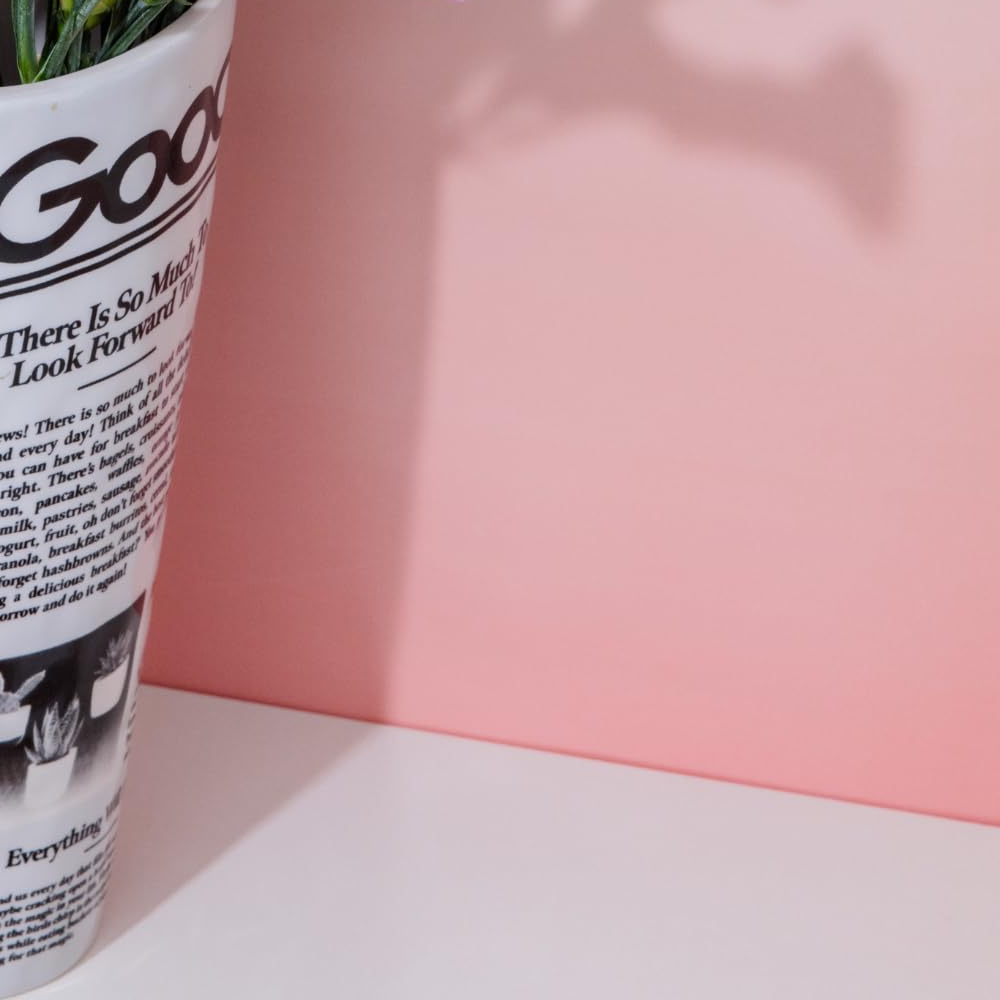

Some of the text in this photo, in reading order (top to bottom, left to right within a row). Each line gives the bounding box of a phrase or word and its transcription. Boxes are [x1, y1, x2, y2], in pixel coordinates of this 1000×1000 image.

[86, 302, 110, 334] Is
[114, 288, 144, 322] So
[146, 243, 195, 304] Much
[9, 344, 84, 388] Look
[86, 284, 177, 365] Forward
[34, 414, 76, 436] There
[81, 407, 92, 421] is
[96, 401, 110, 416] so
[113, 379, 144, 406] much
[19, 439, 58, 456] every
[64, 424, 94, 446] day!
[100, 403, 134, 433] Think
[22, 462, 47, 476] can
[53, 449, 85, 468] have
[90, 439, 110, 456] for
[0, 481, 41, 501] right.
[48, 462, 95, 487] There's
[35, 482, 98, 514] pancakes,
[0, 518, 36, 536] milk,
[42, 500, 96, 531] pastries,
[44, 523, 78, 543] fruit,
[83, 513, 97, 531] oh
[48, 530, 105, 559] breakfast
[13, 594, 20, 602] a
[29, 574, 85, 599] delicious
[43, 596, 68, 612] and
[69, 592, 83, 605] do
[86, 585, 95, 597] it
[97, 563, 127, 592] again!
[6, 818, 102, 868] Everything
[4, 916, 23, 927] the
[6, 928, 25, 939] the
